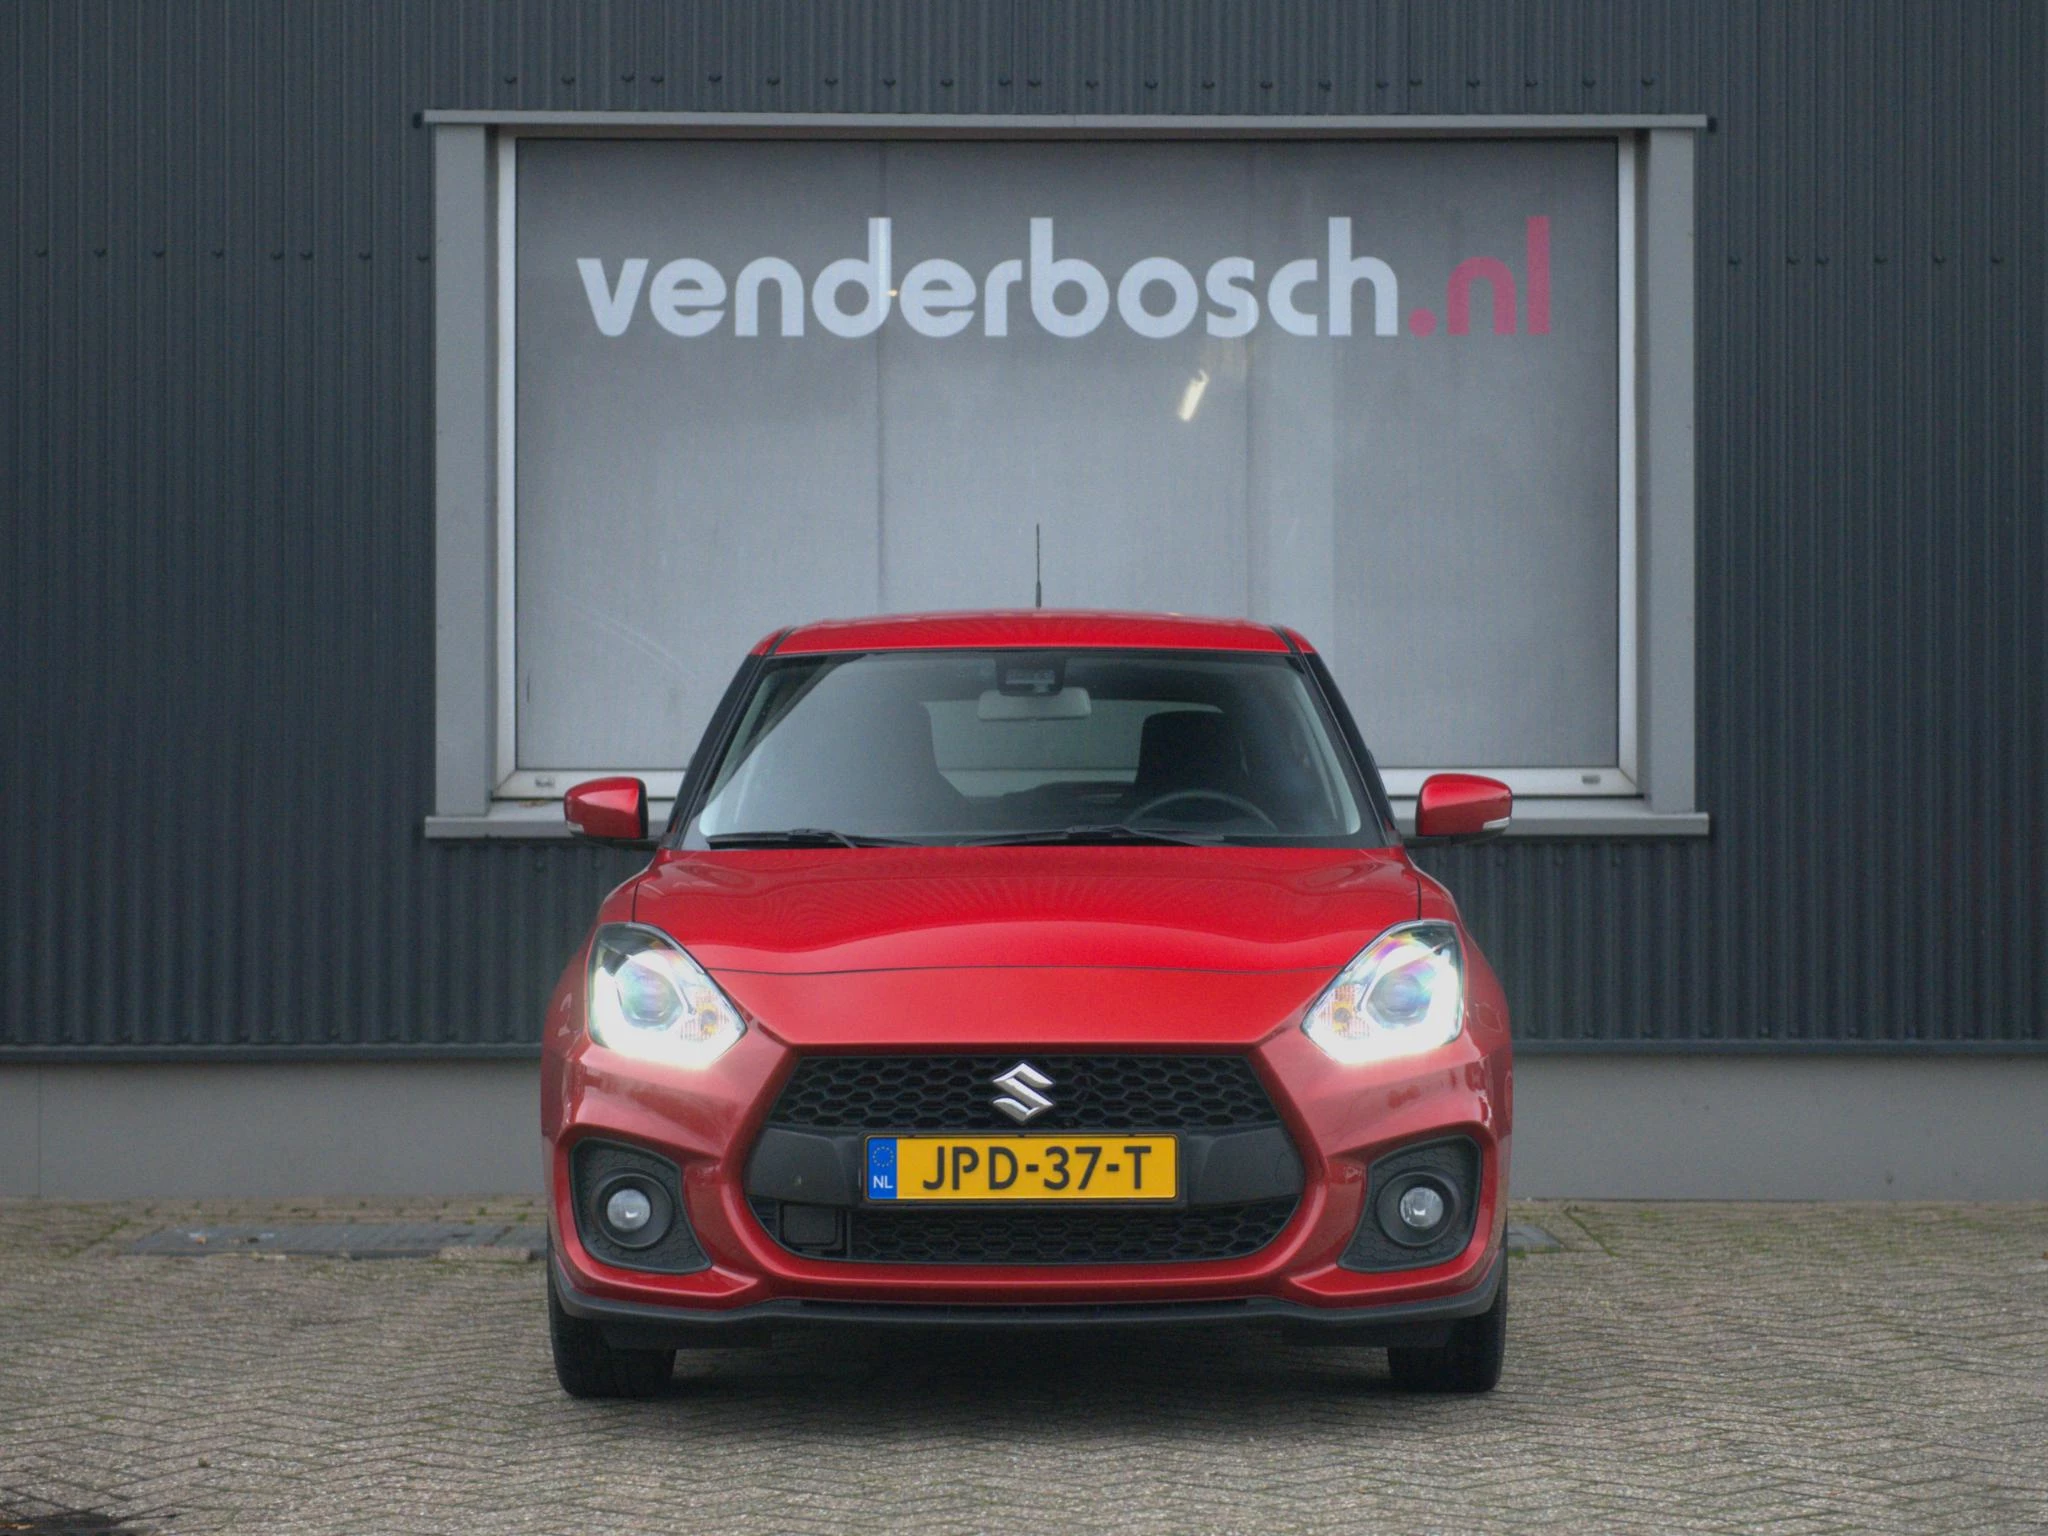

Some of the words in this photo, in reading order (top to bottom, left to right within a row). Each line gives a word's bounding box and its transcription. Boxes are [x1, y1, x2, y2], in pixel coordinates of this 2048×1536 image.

[576, 216, 1550, 338] venderbosch.nl
[873, 1176, 893, 1189] NL
[922, 1145, 1152, 1190] JPD-37-T
